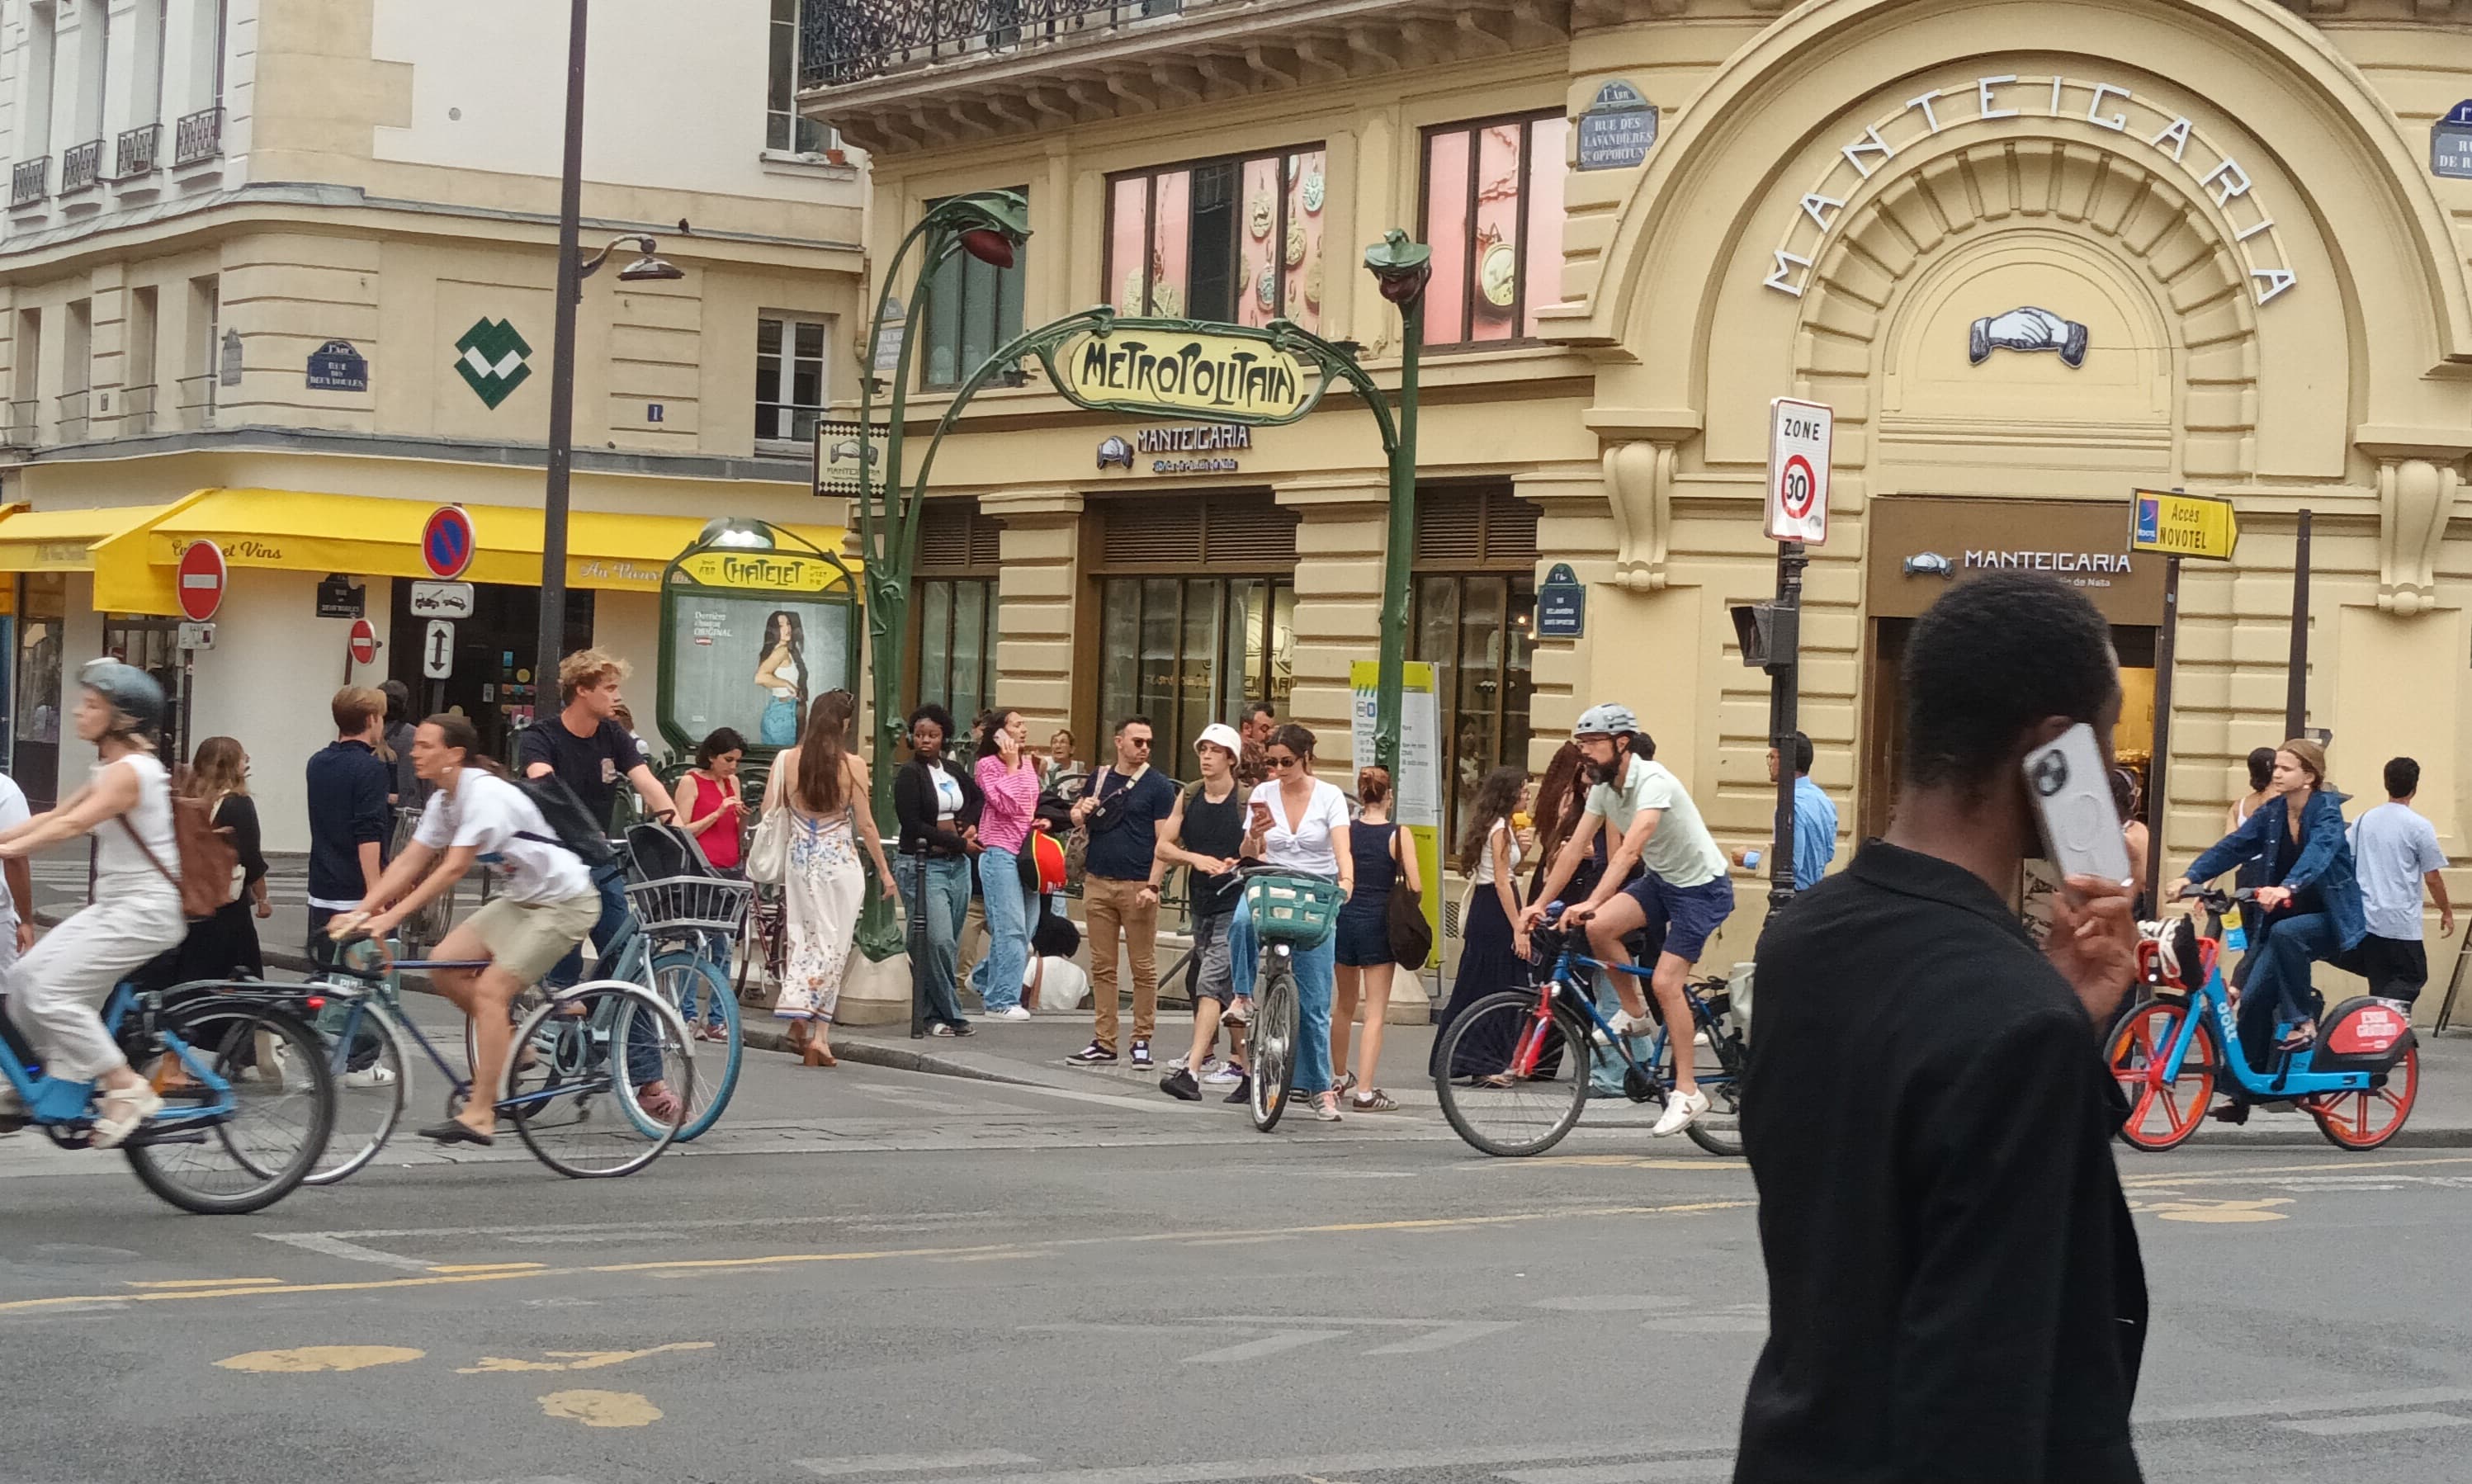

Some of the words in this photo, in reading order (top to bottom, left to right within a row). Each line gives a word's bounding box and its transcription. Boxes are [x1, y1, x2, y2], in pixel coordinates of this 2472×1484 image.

[1595, 119, 1617, 132] RUE
[1620, 117, 1641, 130] DES
[2439, 154, 2457, 168] DE
[1763, 75, 2297, 305] MANTEIGARIA
[1081, 341, 1296, 408] METROPOLITAIN
[1137, 424, 1250, 452] MANTEIGARIA
[1784, 418, 1820, 441] ZONE
[1786, 473, 1807, 502] 30
[2172, 503, 2200, 522] Accès
[2159, 527, 2206, 550] NOVOTEL
[240, 541, 283, 560] Vins
[1964, 550, 2132, 573] MANTEIGARIA
[2073, 578, 2086, 587] de
